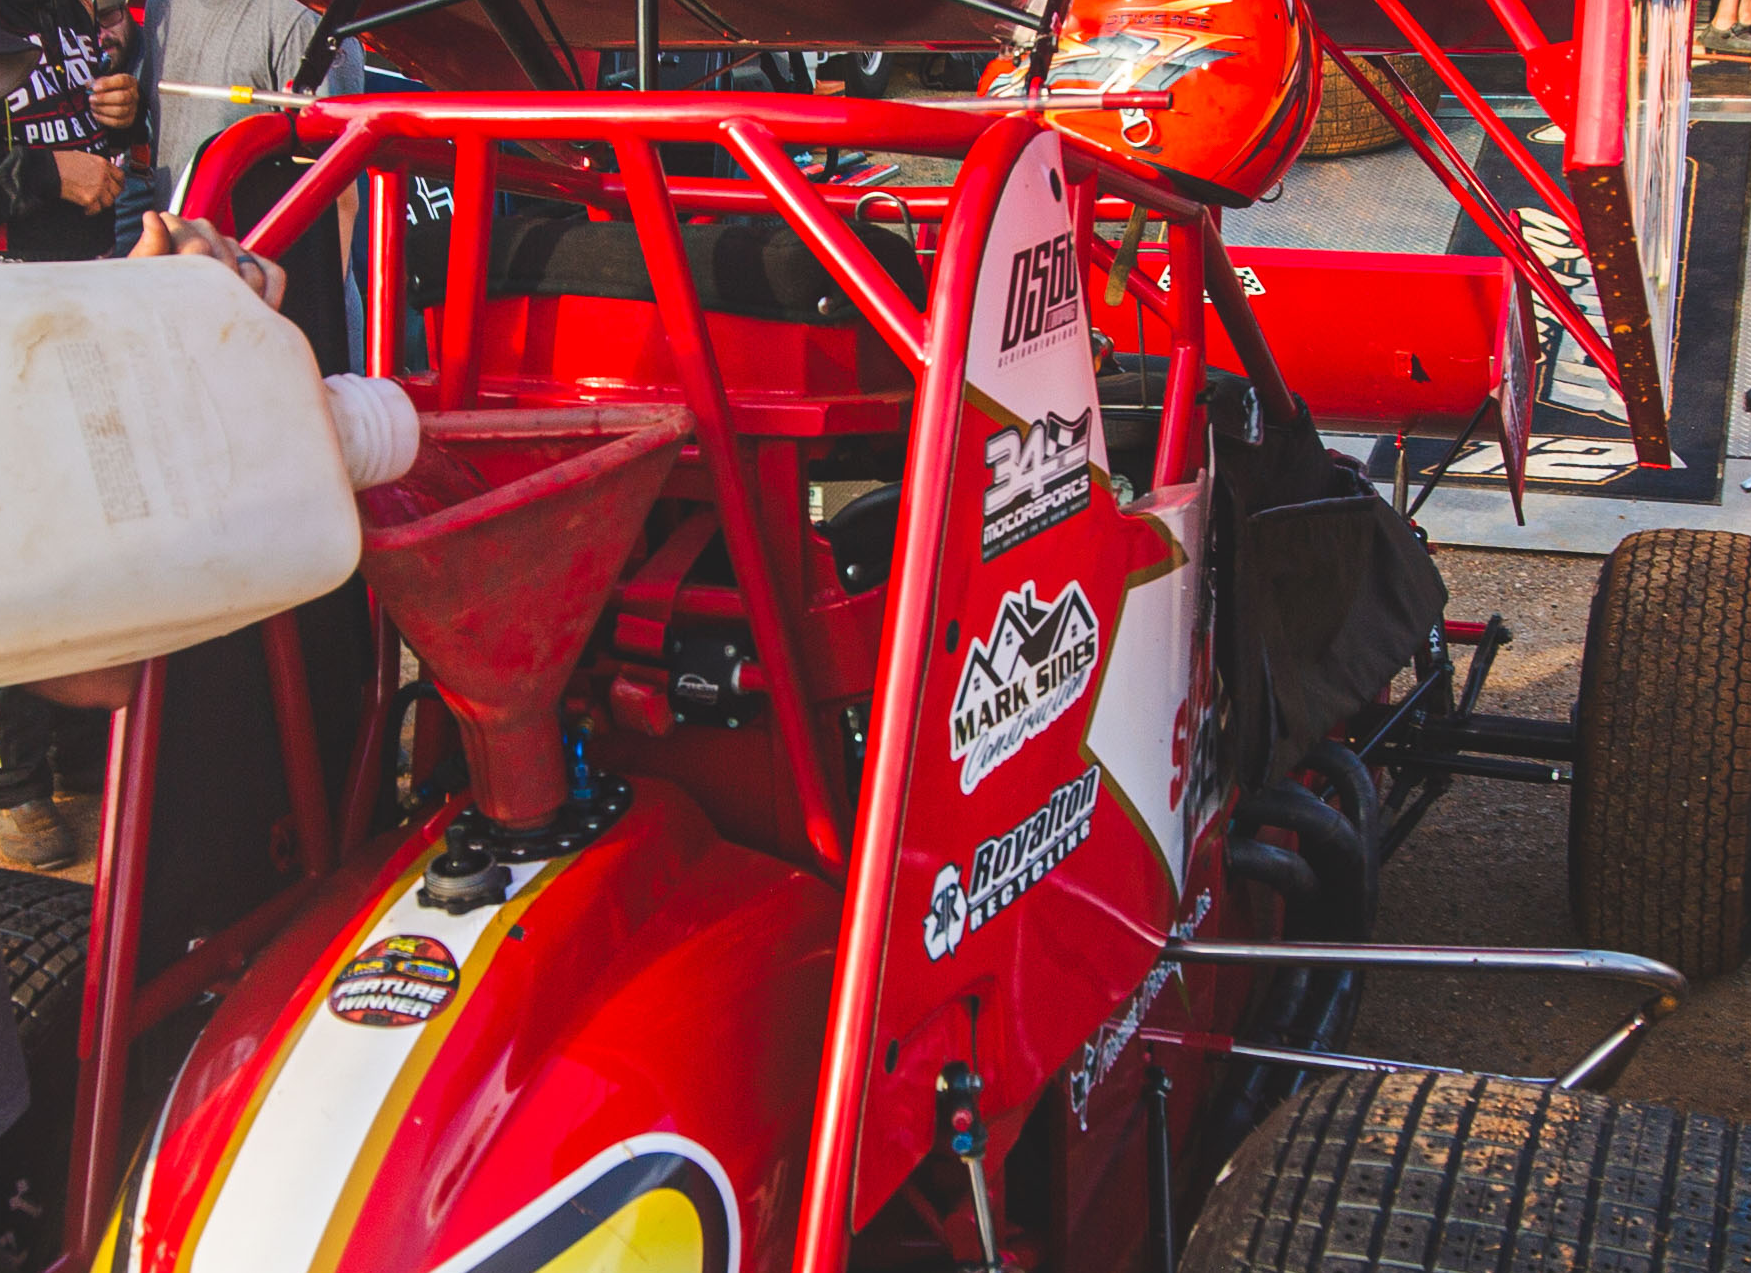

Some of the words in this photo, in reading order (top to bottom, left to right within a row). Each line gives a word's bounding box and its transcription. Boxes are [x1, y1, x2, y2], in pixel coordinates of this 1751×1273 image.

[25, 118, 69, 144] PUB
[984, 419, 1046, 517] 34
[954, 677, 1030, 751] MARK
[1036, 632, 1096, 698] SIDES
[970, 766, 1098, 897] Royalton
[970, 819, 1090, 931] RECYCLING
[333, 979, 448, 1004] FEATURE
[336, 995, 433, 1019] WINNER
